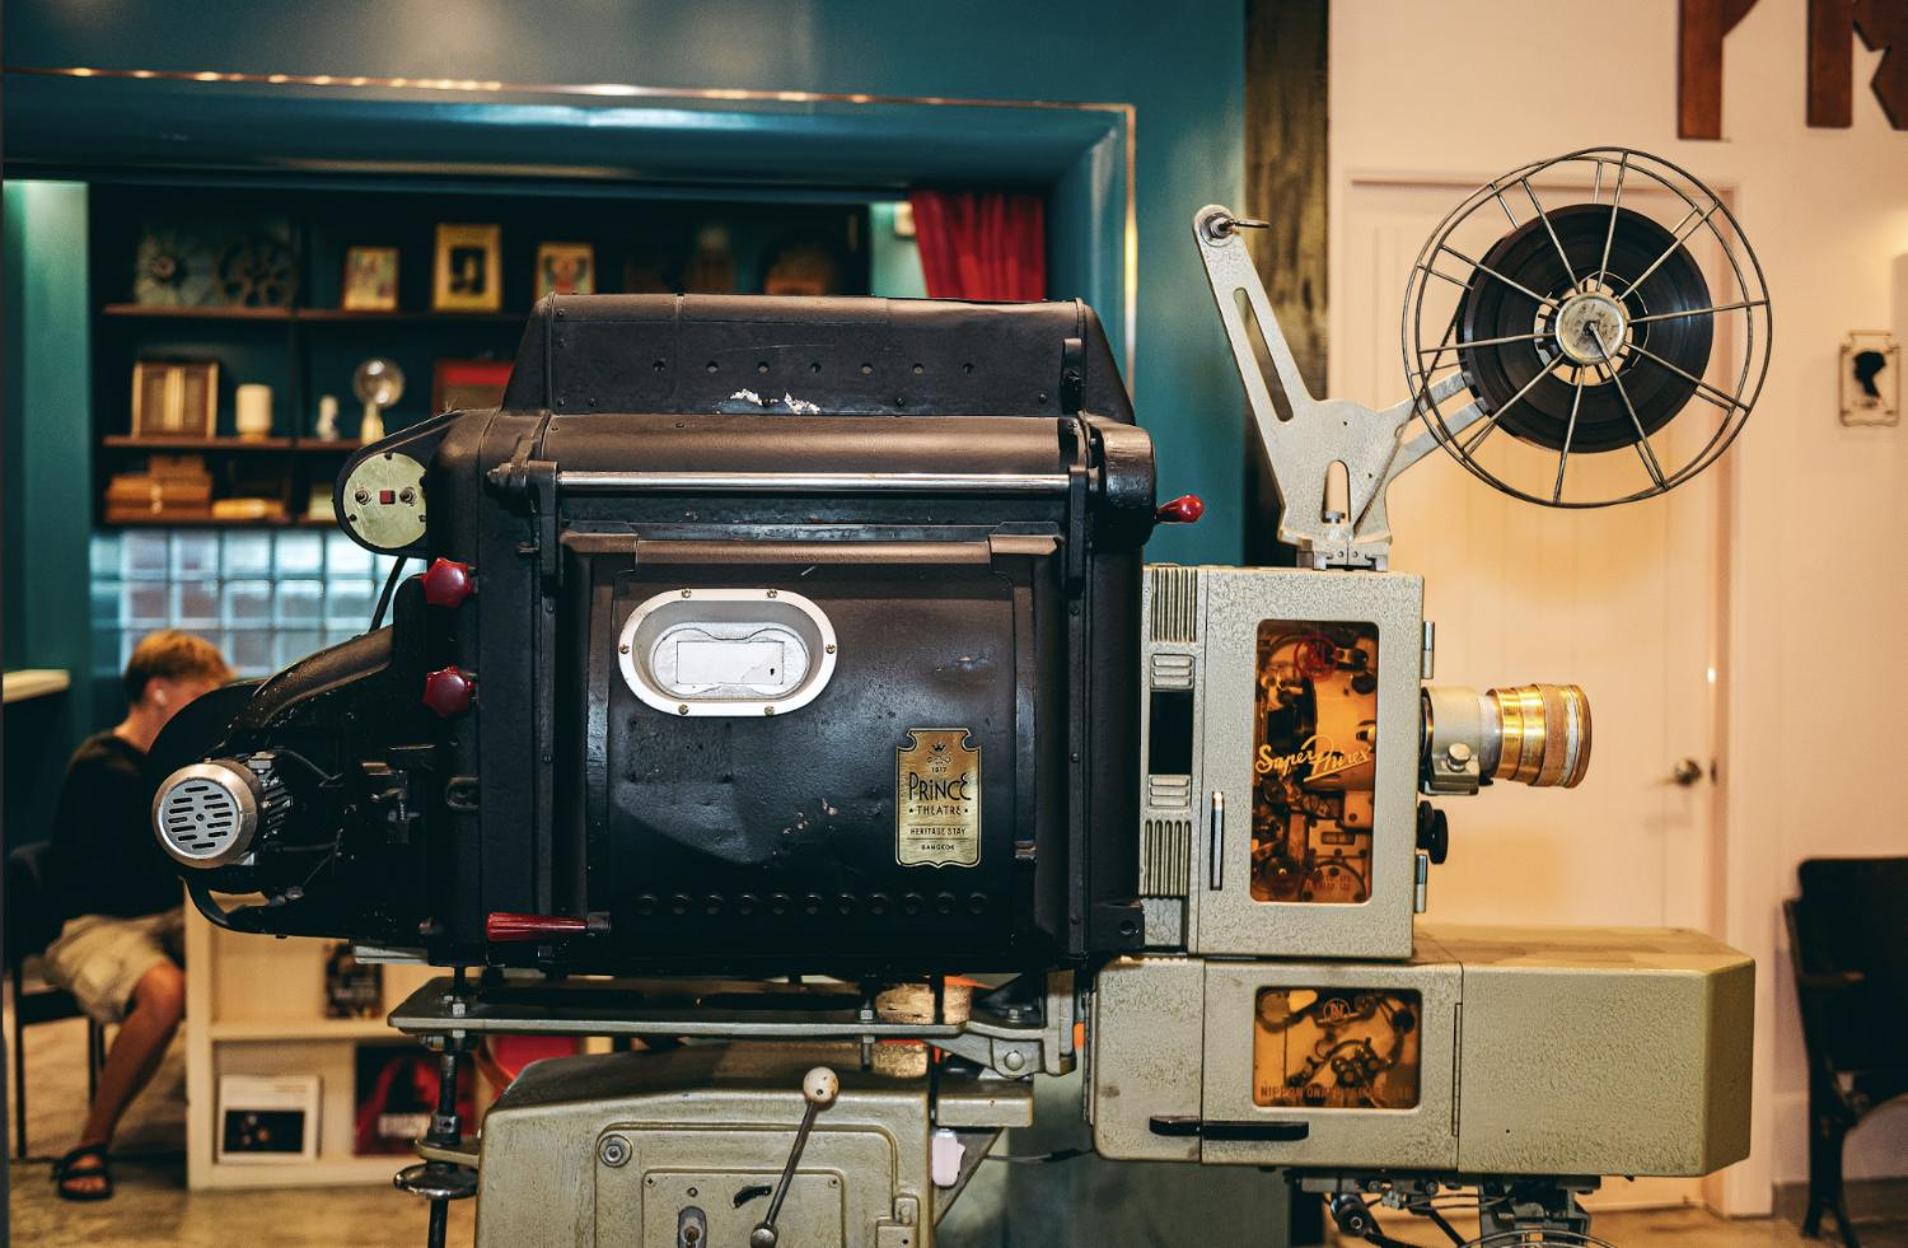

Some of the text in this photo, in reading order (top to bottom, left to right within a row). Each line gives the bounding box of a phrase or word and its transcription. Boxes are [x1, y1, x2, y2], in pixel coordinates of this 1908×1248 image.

[917, 805, 962, 816] THEATRE
[910, 828, 966, 836] HERITAGE STAY
